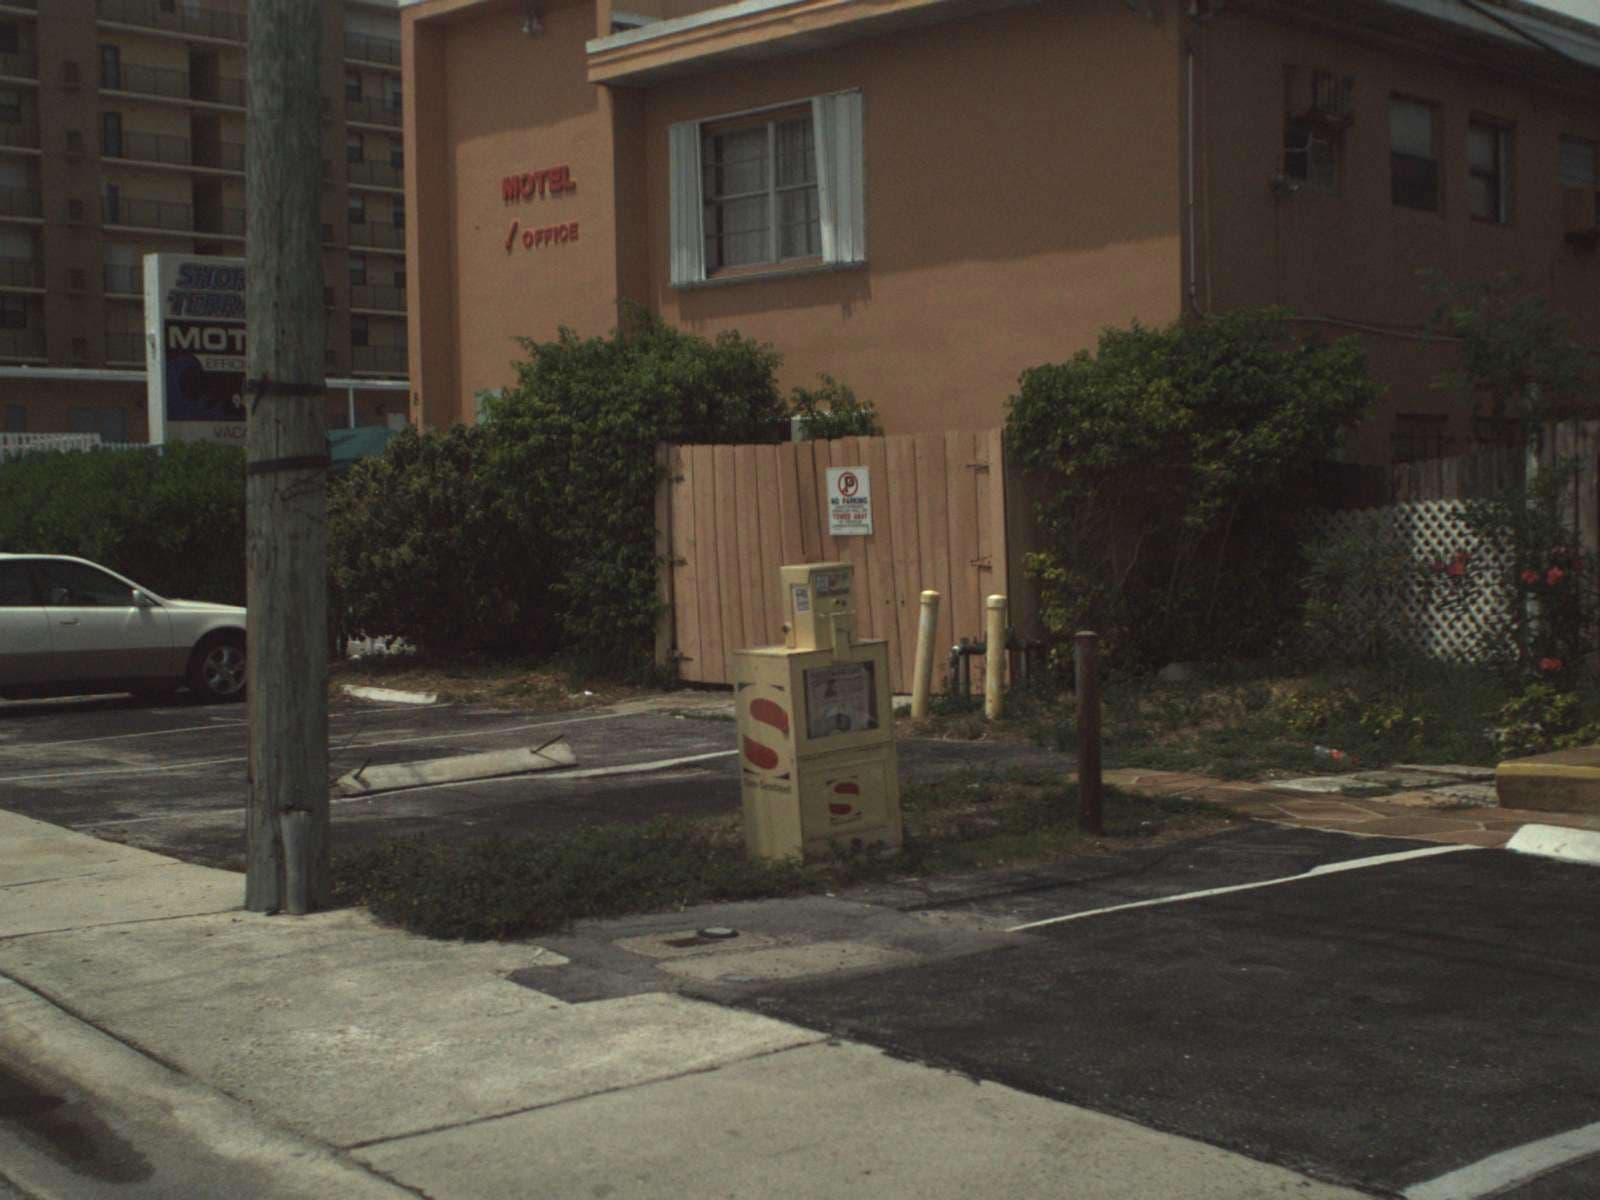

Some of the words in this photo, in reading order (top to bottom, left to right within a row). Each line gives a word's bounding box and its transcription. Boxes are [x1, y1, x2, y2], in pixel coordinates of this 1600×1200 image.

[502, 165, 577, 203] MOTEL
[523, 222, 578, 249] OFFICE
[842, 496, 867, 504] PARKING
